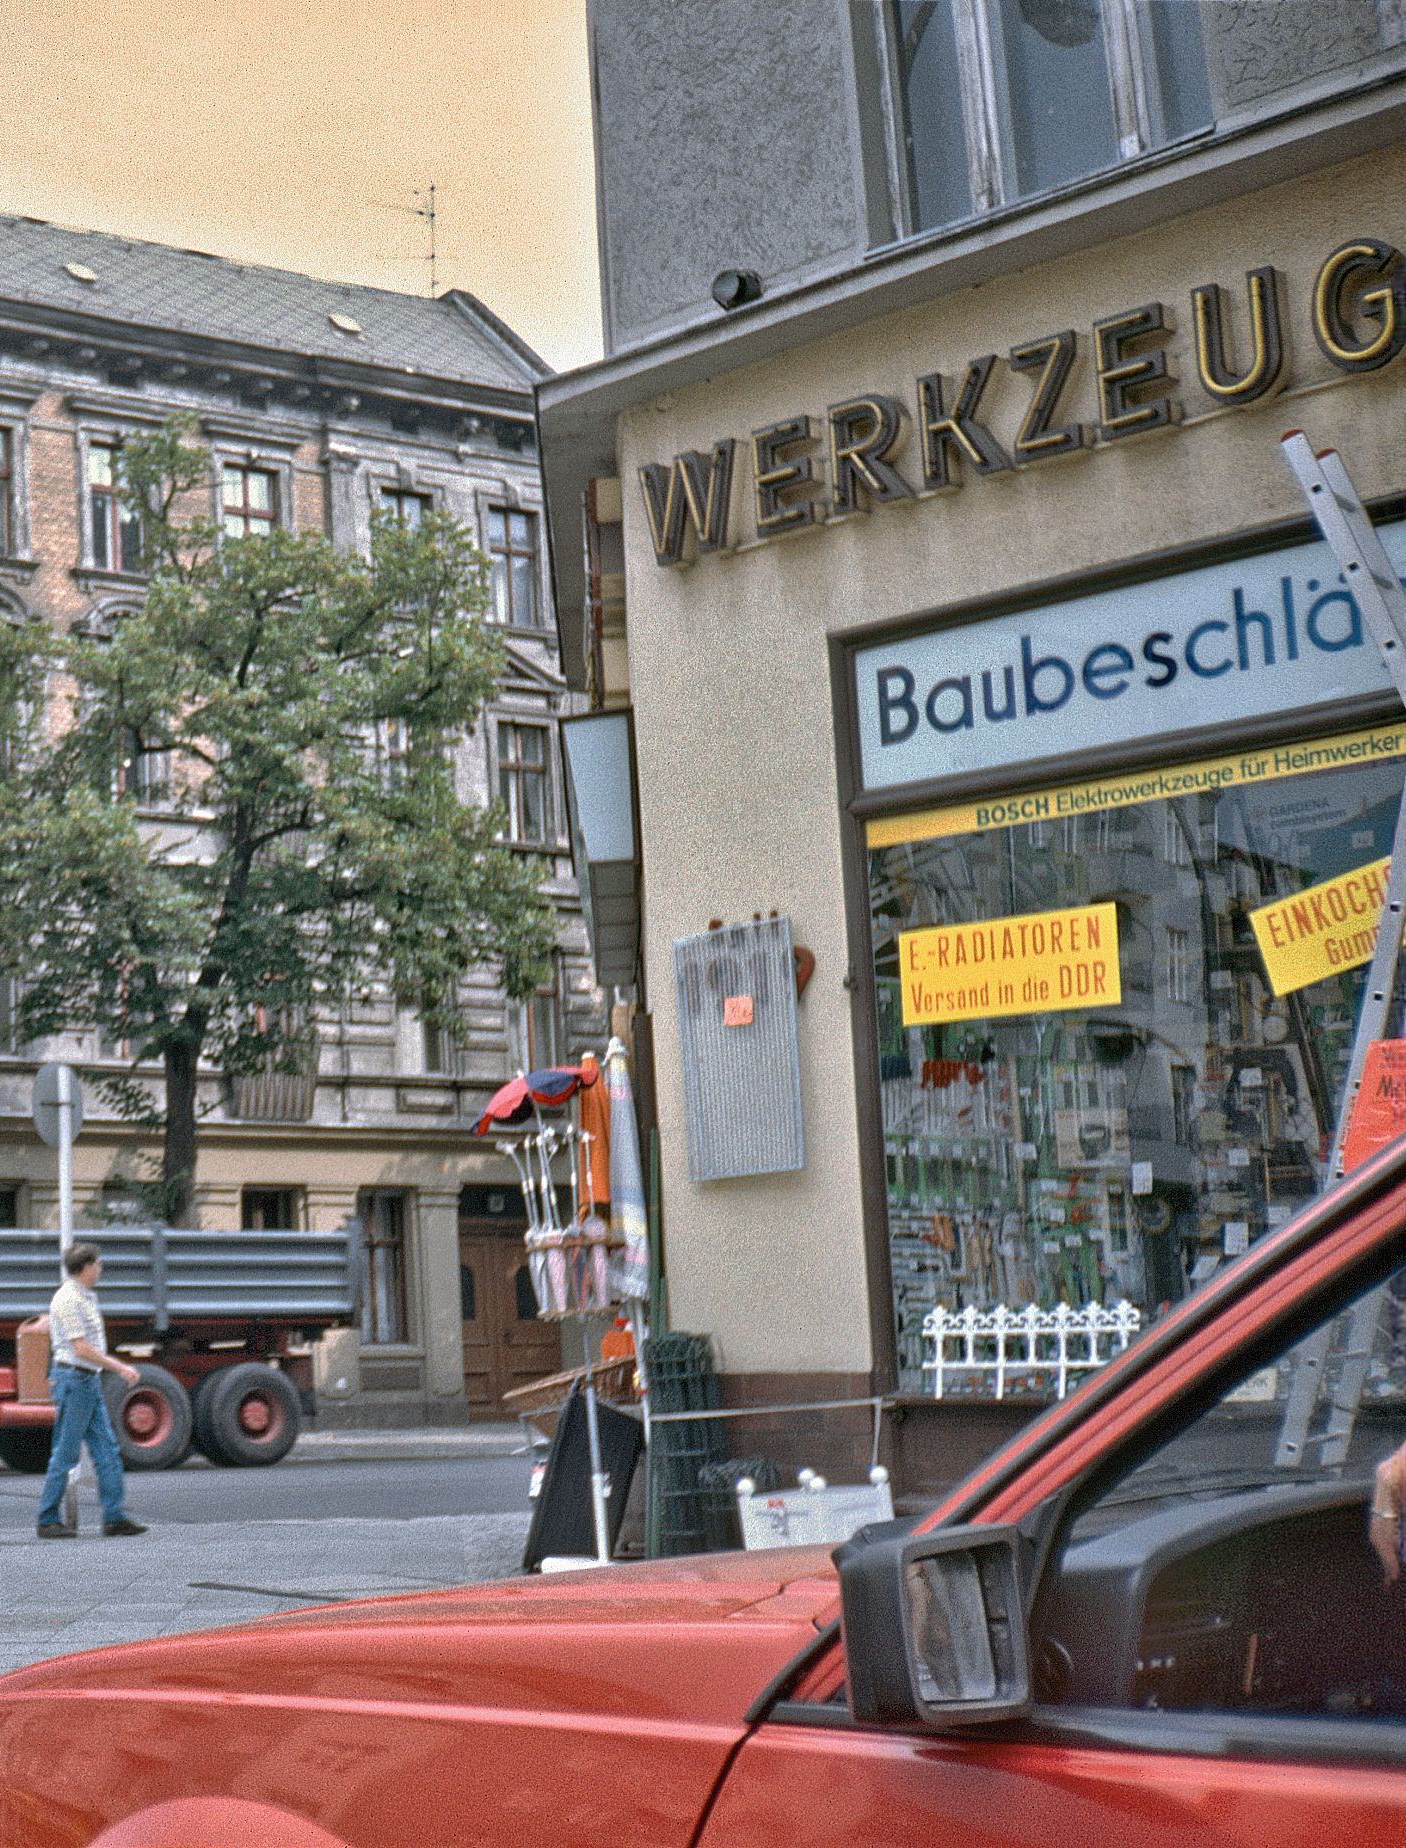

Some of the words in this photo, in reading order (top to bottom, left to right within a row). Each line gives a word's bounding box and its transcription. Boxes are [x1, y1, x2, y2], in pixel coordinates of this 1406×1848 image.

[637, 237, 1406, 567] WERKZEUG
[875, 571, 1388, 747] Baubeschlä
[975, 795, 1050, 828] BOSCH
[1055, 762, 1235, 813] Elektrowerkzeuge
[1239, 750, 1268, 781] für
[1274, 733, 1402, 772] Heimwerker
[910, 981, 990, 1015] Versand
[998, 980, 1014, 1005] in
[1022, 976, 1050, 1003] die
[1059, 960, 1107, 1000] DDR
